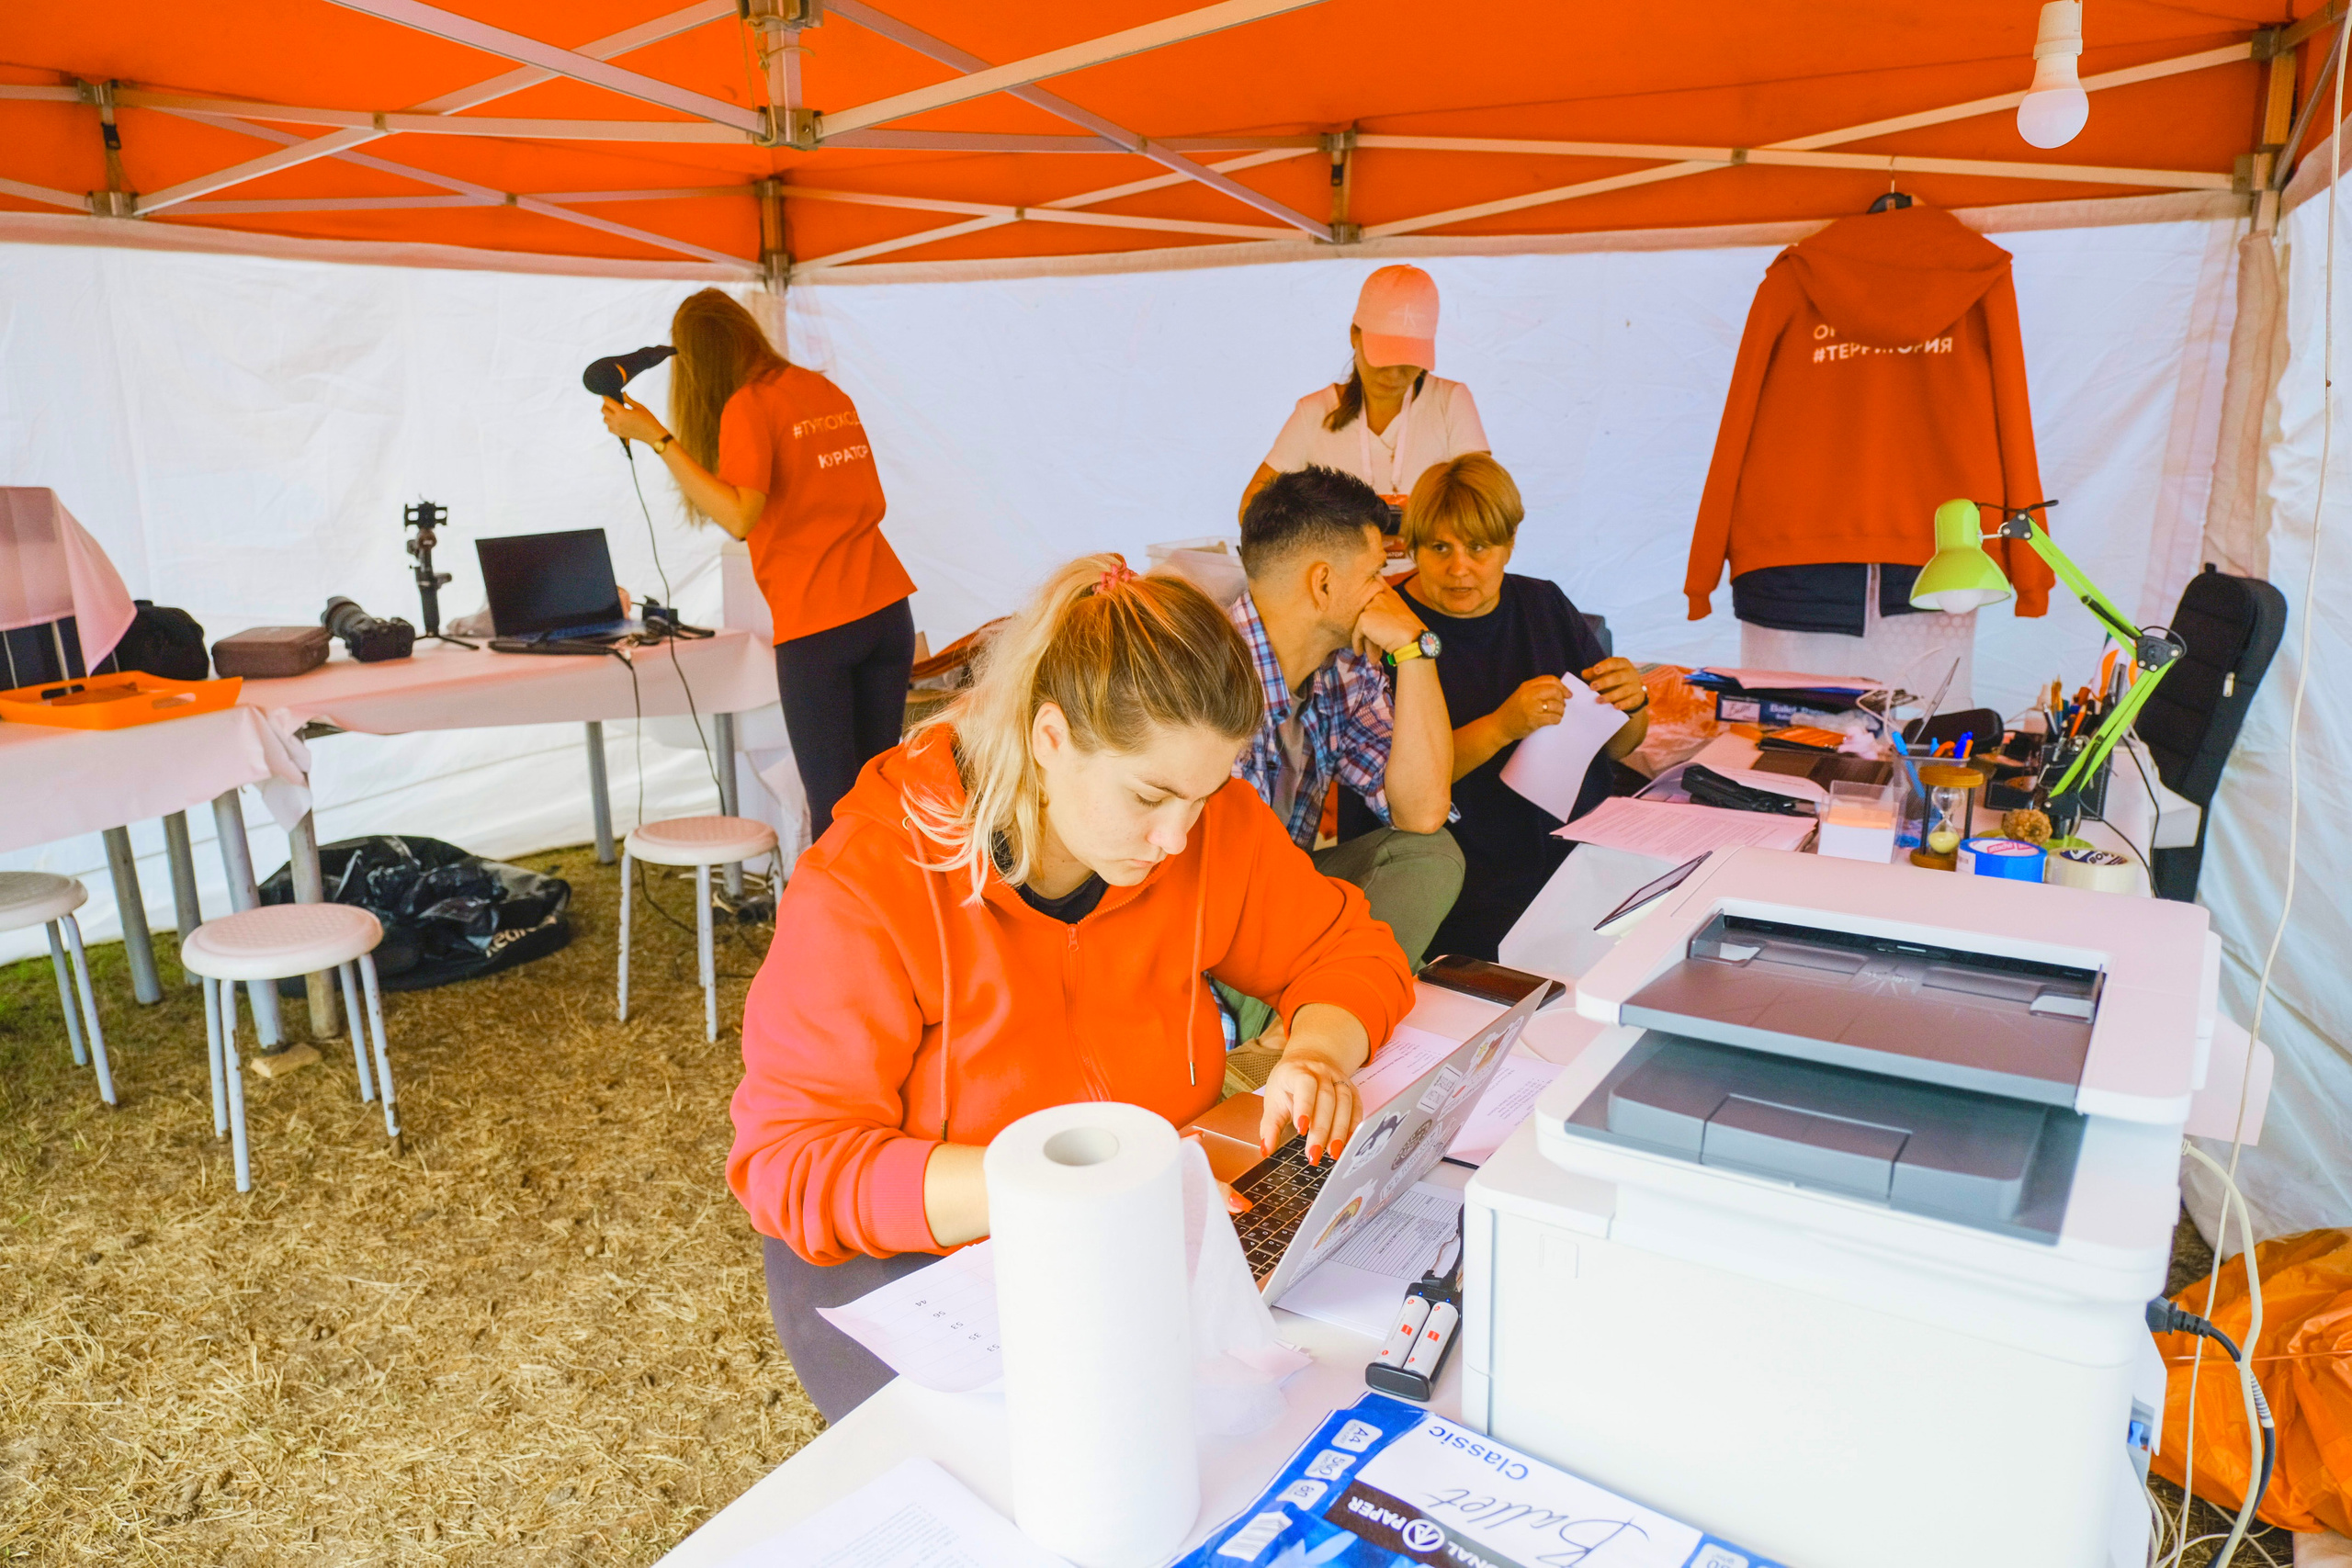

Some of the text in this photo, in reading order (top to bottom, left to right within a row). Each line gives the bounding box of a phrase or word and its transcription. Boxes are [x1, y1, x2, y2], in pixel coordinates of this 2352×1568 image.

[1813, 336, 1953, 364] #ТЕРИЯ
[1349, 1427, 1369, 1443] A4
[1429, 1426, 1529, 1480] Classic
[1347, 1496, 1408, 1531] PAPER
[1421, 1488, 1650, 1568] Ballet
